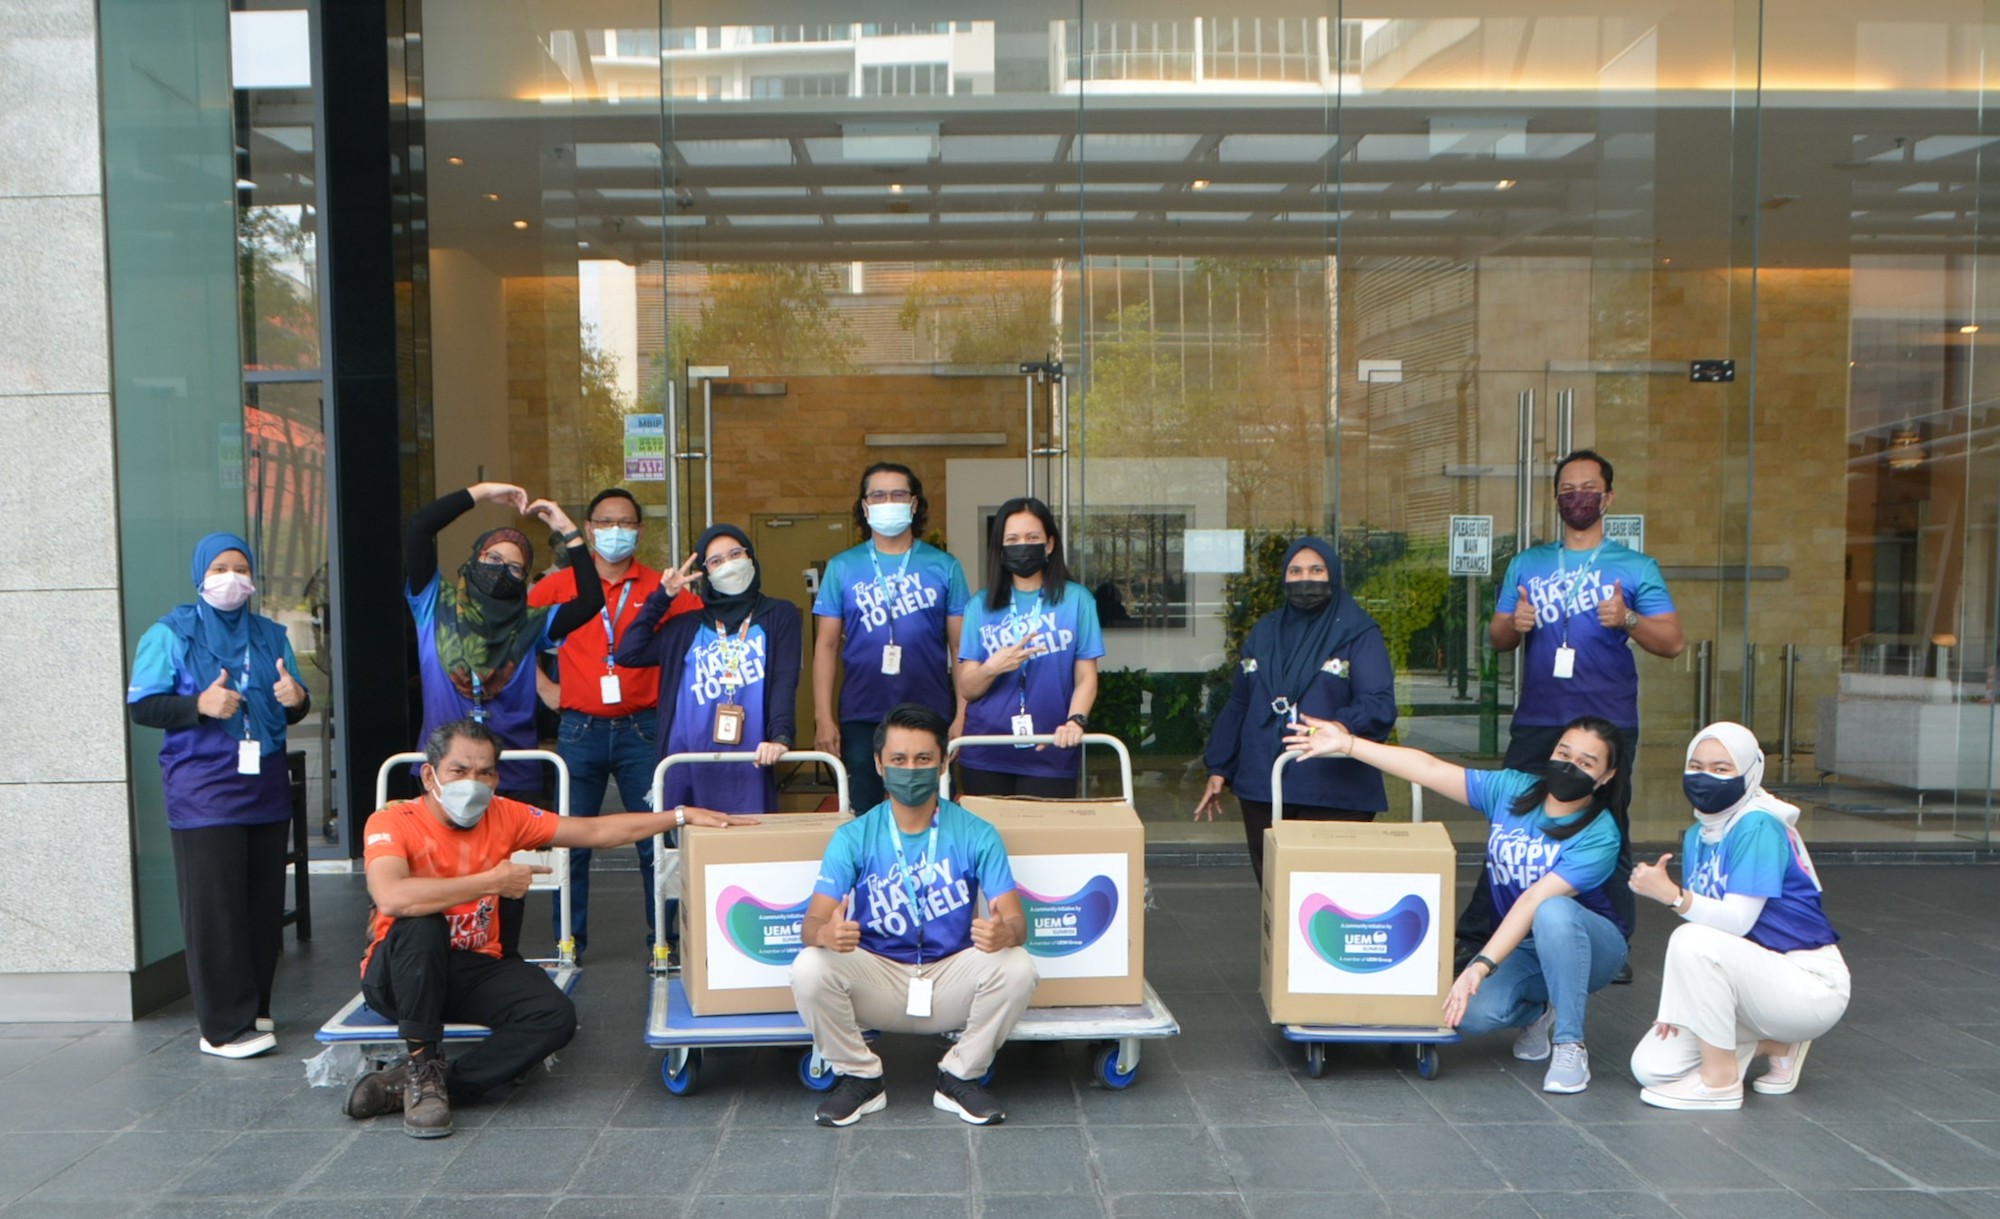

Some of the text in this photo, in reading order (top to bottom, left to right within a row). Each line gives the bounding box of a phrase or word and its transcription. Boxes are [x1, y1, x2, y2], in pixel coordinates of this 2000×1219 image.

[638, 419, 662, 428] MBIP
[1454, 522, 1489, 537] PLEASE USE
[1605, 521, 1640, 537] PLEASE USE
[1463, 539, 1478, 554] MAIN
[1455, 556, 1486, 571] ENTRANCE
[855, 572, 922, 614] HAPPY
[1530, 570, 1601, 611] HAPPY
[860, 587, 938, 633] TO HELP
[982, 612, 1057, 658] HAPPY
[690, 677, 721, 705] TO
[1488, 841, 1560, 867] HAPPY
[1486, 862, 1510, 886] TO
[867, 859, 953, 920] HAPPY
[763, 925, 791, 936] UEM
[867, 911, 907, 937] TO
[1034, 917, 1062, 928] UEM
[1345, 934, 1372, 944] UEM
